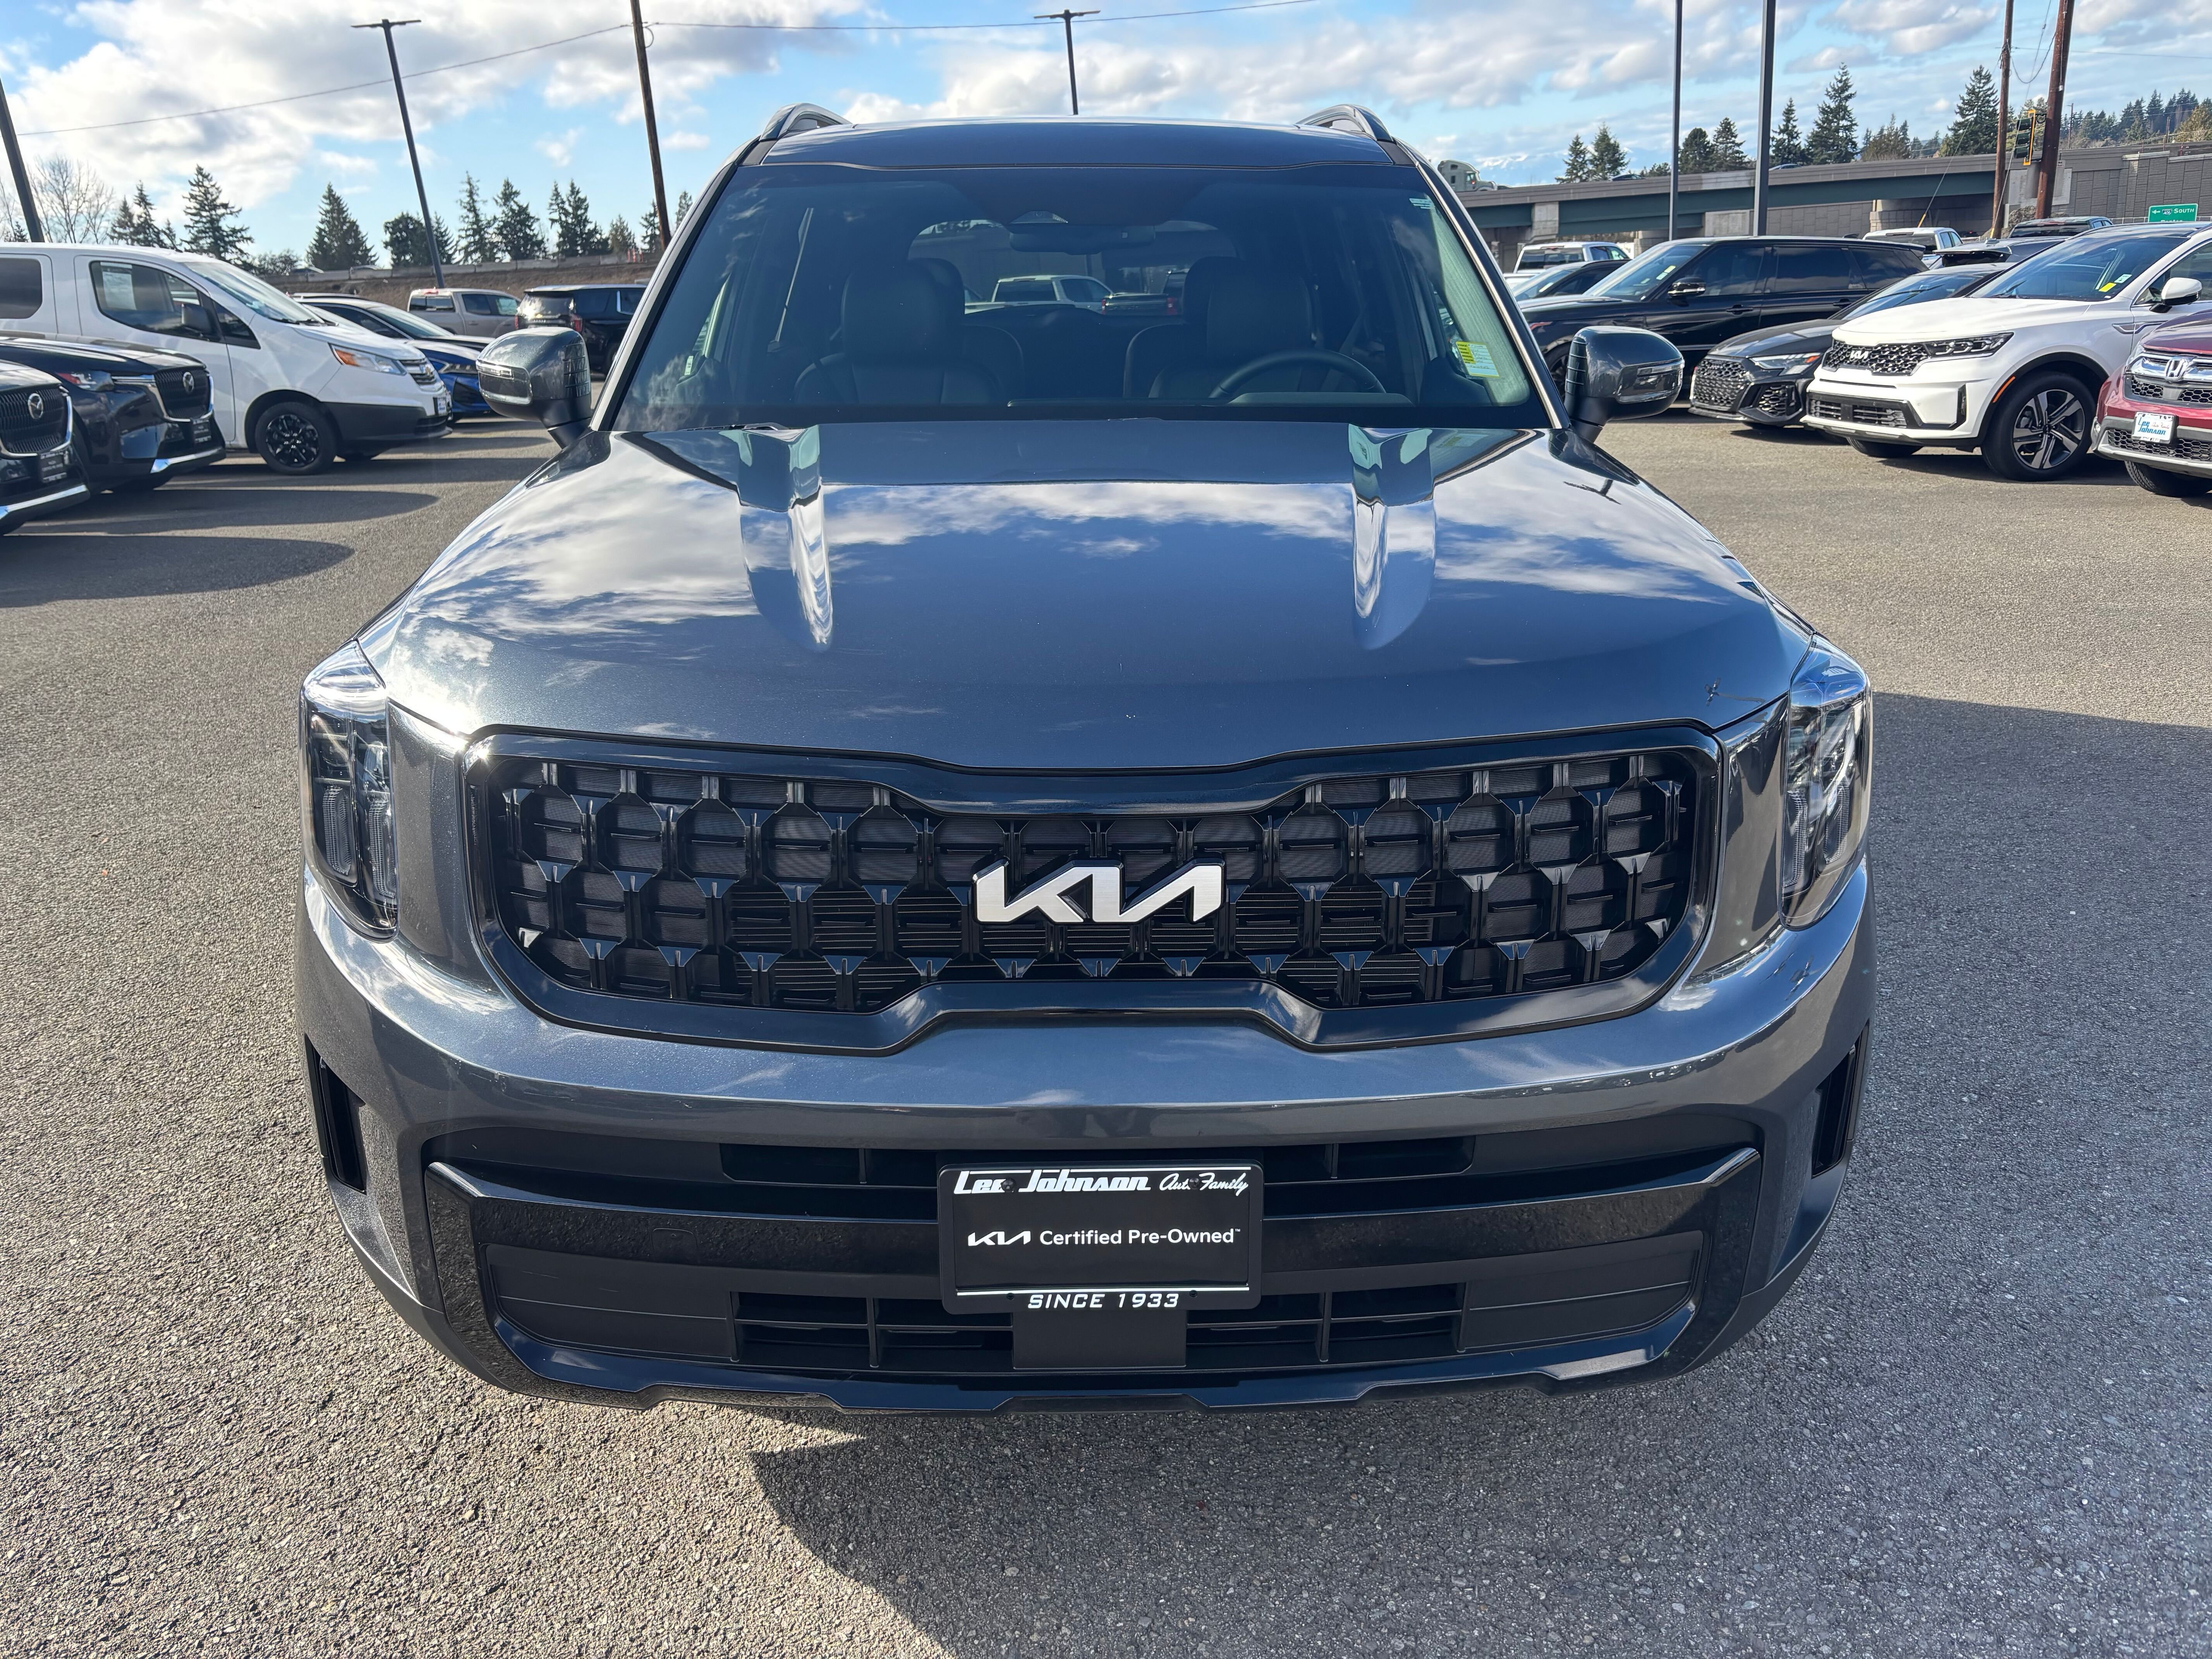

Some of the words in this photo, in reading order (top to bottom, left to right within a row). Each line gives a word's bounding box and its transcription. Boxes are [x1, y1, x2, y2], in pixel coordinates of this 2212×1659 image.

[1850, 350, 1869, 359] KIA
[2138, 425, 2166, 435] Johnson
[975, 864, 1222, 923] KIA
[1018, 1169, 1151, 1192] Johnson
[1199, 1172, 1249, 1196] Family
[968, 1231, 1031, 1246] KIA
[1040, 1230, 1122, 1245] Certified
[1028, 1293, 1105, 1309] SINCE
[1119, 1293, 1179, 1308] 1933
